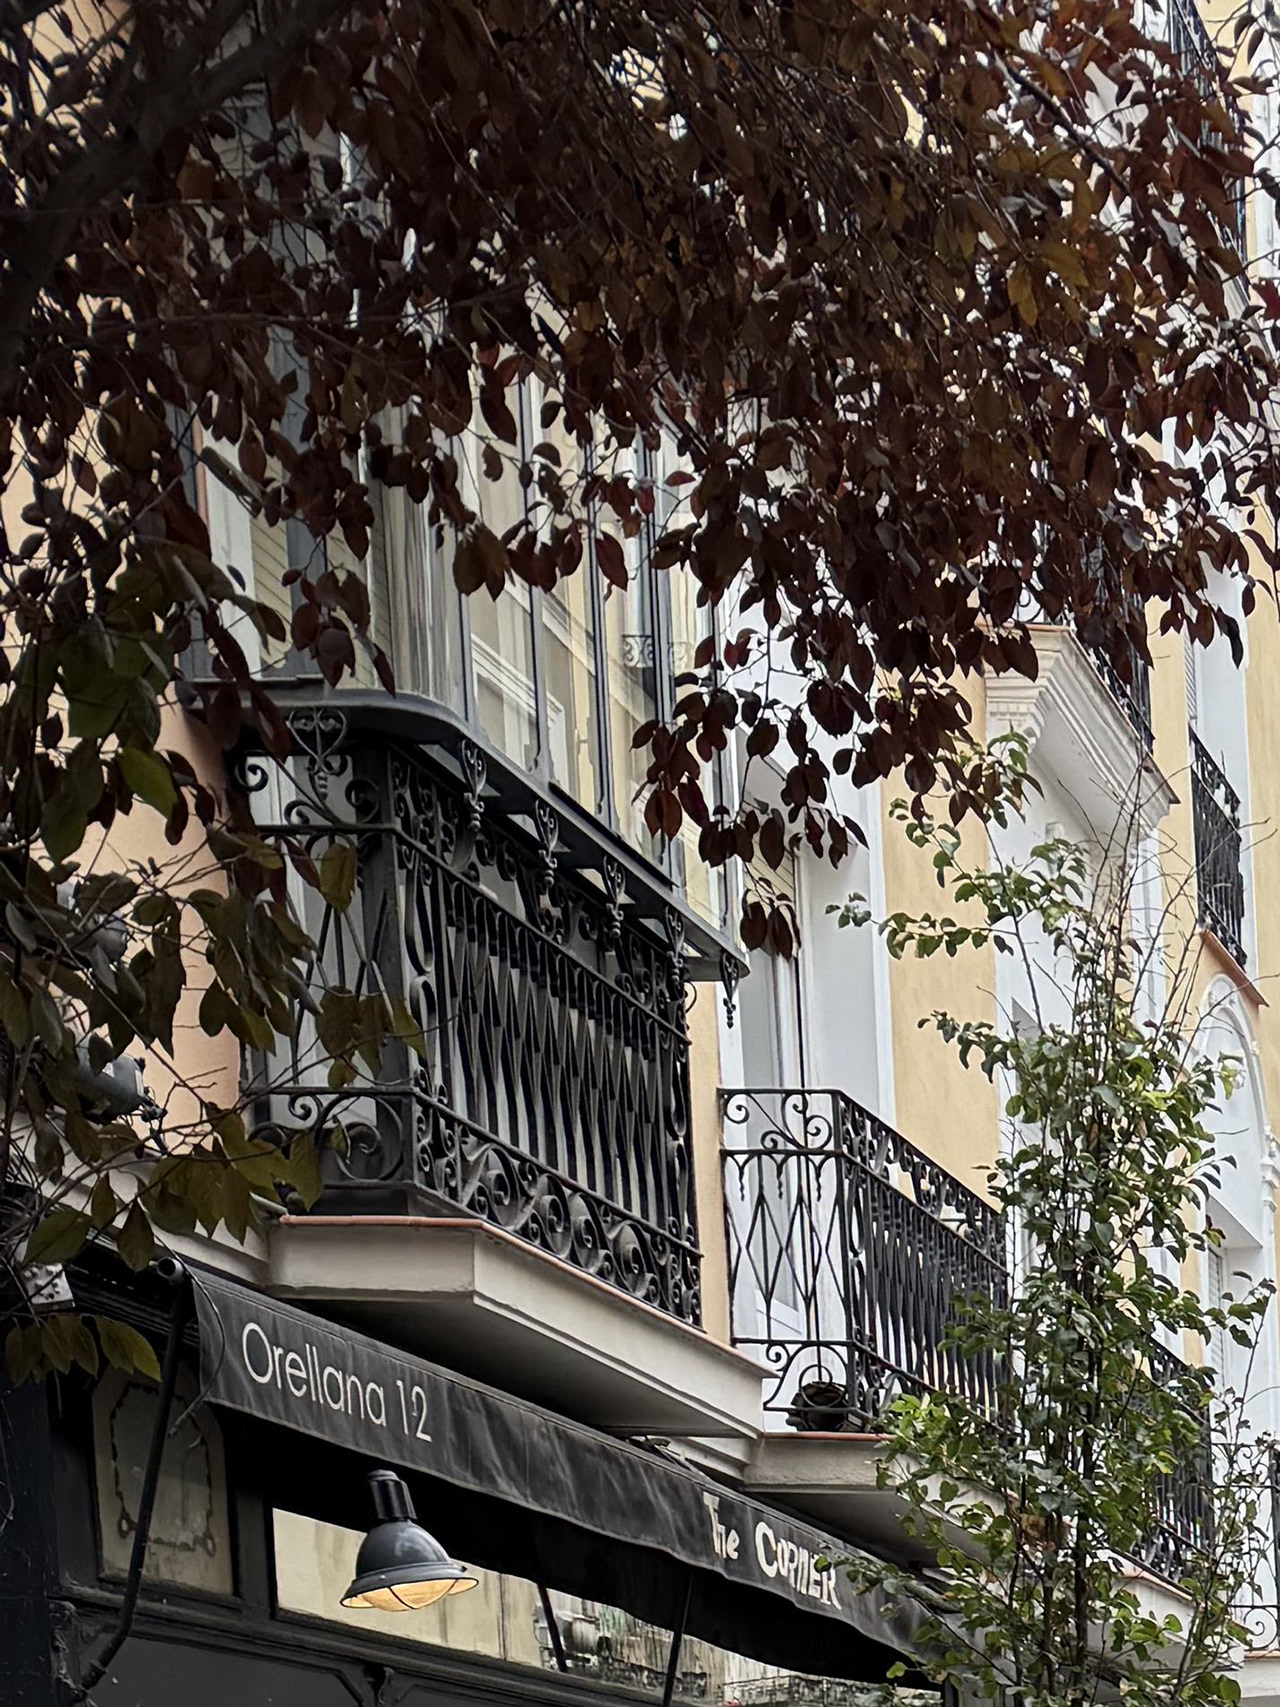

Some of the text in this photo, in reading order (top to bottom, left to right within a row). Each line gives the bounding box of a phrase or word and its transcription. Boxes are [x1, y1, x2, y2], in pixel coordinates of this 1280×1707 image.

[242, 1322, 433, 1443] Orellana 12
[703, 1491, 740, 1560] The
